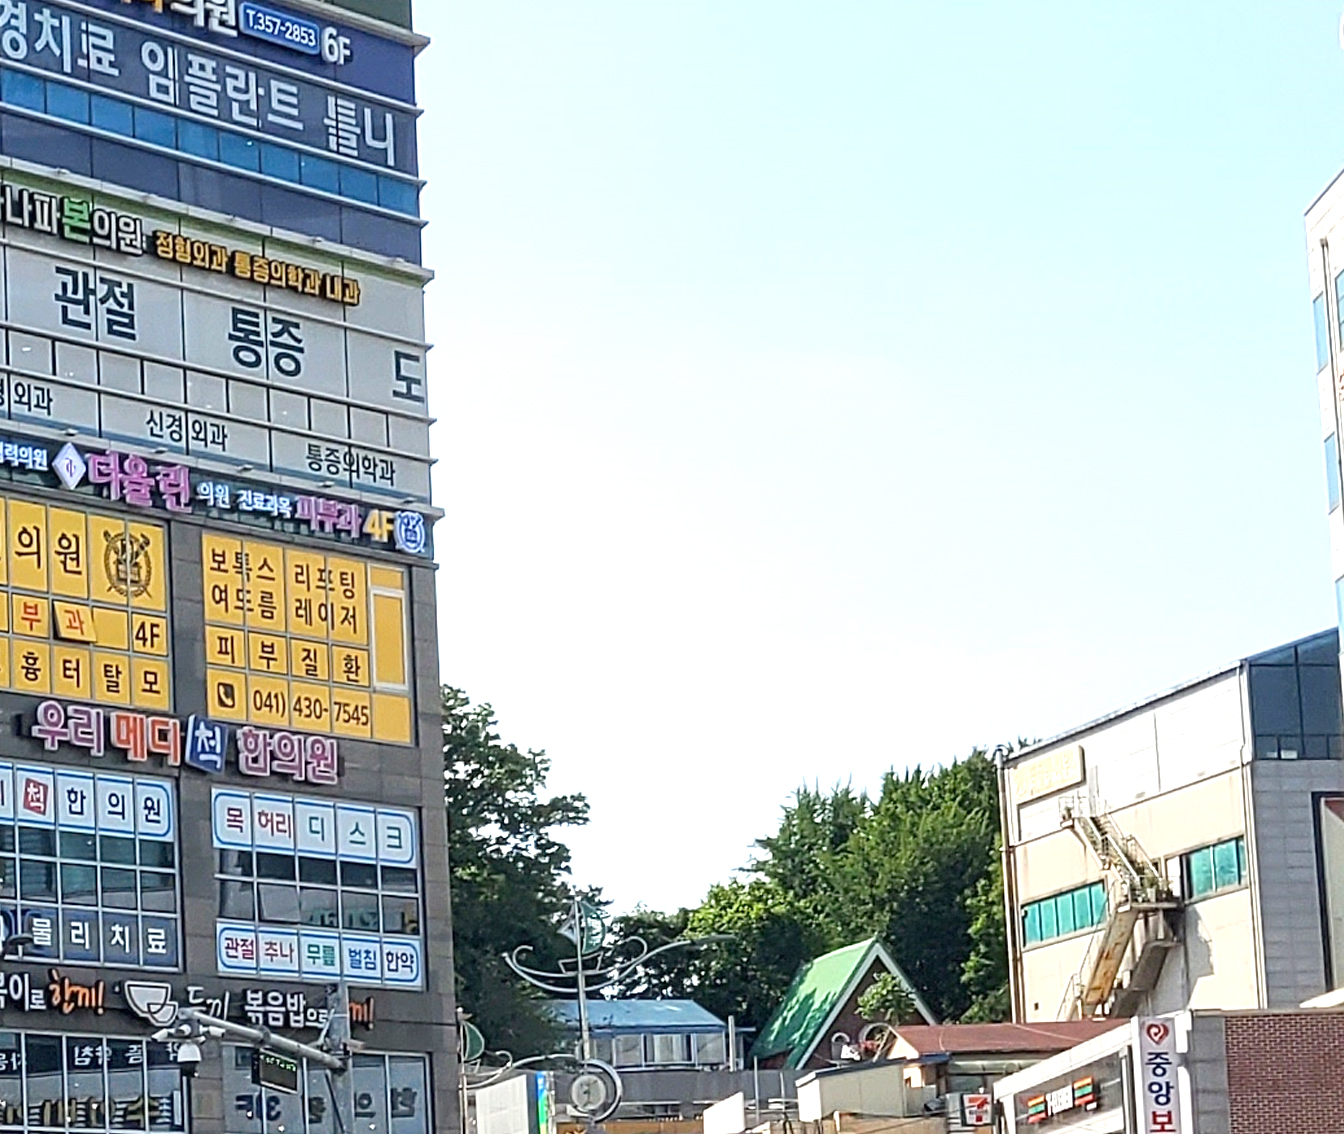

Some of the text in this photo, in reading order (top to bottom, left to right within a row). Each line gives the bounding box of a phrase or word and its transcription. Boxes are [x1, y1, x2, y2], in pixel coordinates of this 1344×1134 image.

[323, 27, 350, 64] 6F
[141, 40, 305, 131] 임플란트
[324, 85, 395, 167] 틀니
[155, 231, 231, 274] 정형외과
[233, 251, 324, 295] 통증의학과
[326, 273, 361, 307] 내과
[54, 265, 138, 340] 관절
[228, 305, 305, 378] 통증
[146, 410, 229, 453] 신경외과
[305, 443, 396, 488] 통증의학과
[86, 448, 192, 514] 더올린
[197, 481, 231, 508] 의원
[236, 488, 292, 520] 진료과목
[294, 497, 363, 539] 피부과
[362, 513, 396, 544] 4F
[209, 548, 356, 599] 보톡스 리프팅
[135, 620, 161, 648] 4F
[211, 585, 358, 634] 여드름 레이저
[252, 690, 370, 727] 041) 430- 7545
[237, 727, 340, 785] 한의원
[225, 807, 404, 852] 목 허리 디스크
[32, 917, 167, 956] 물리치료
[223, 935, 415, 975] 관절 추나 무릎 벌침 한약
